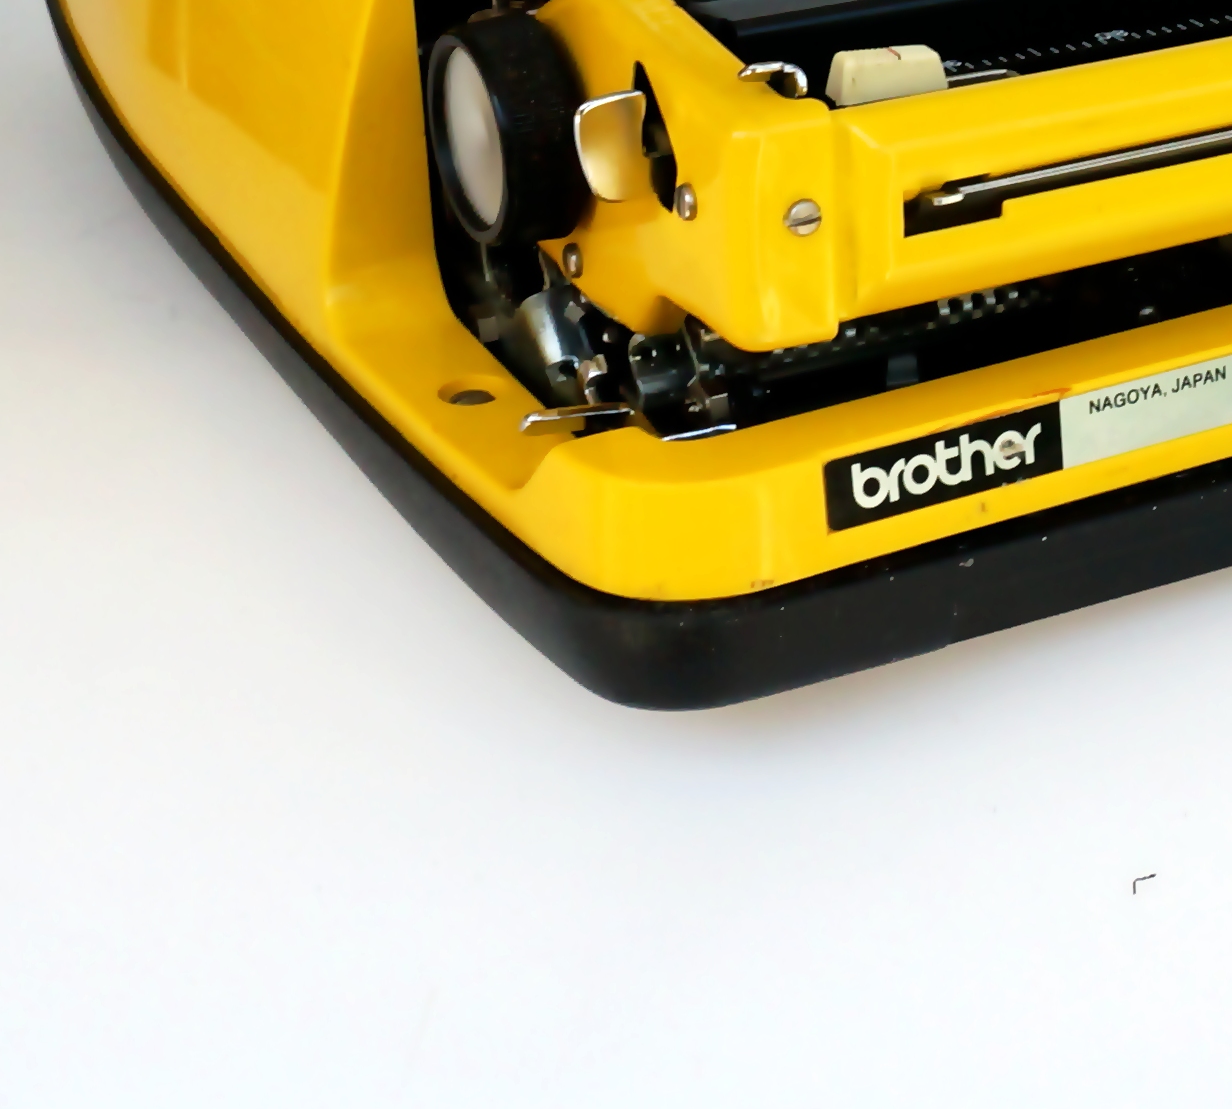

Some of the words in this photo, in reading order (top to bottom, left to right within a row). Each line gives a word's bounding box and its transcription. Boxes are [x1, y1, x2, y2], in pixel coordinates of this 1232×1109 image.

[1089, 383, 1168, 414] NAGOYA,
[1171, 366, 1227, 393] JAPAN
[851, 422, 1041, 509] brother
